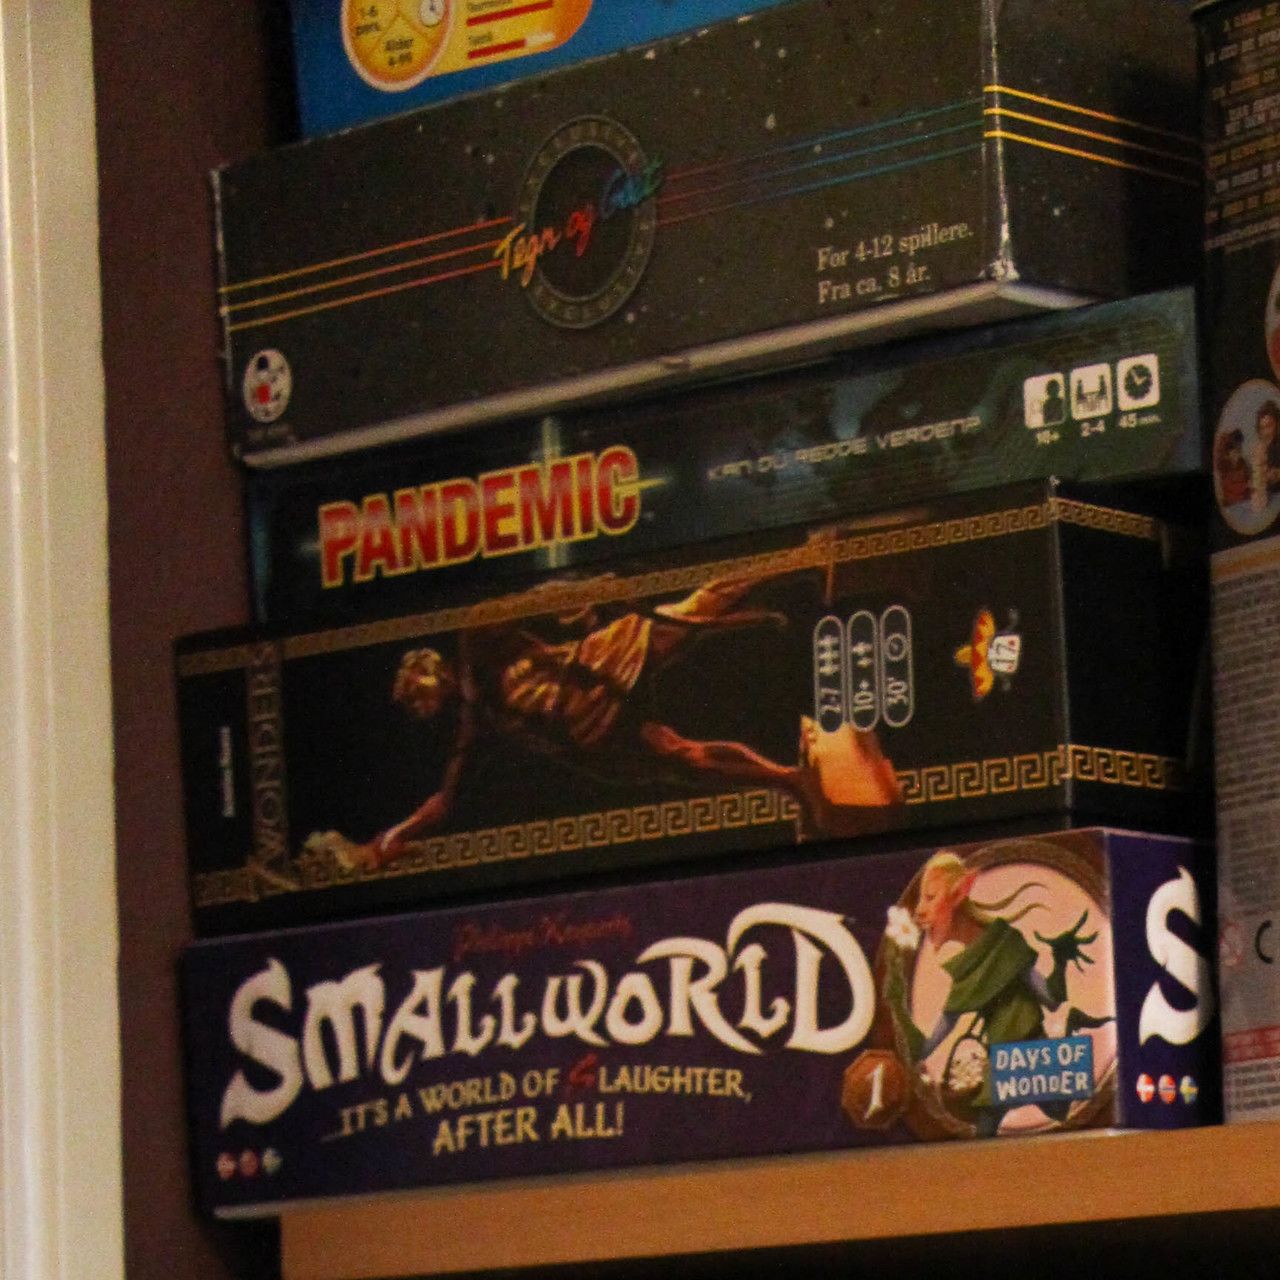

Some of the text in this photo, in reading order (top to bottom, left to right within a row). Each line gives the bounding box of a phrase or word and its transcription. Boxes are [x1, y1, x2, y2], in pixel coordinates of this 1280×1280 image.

[816, 221, 975, 271] For 4-12 spillere.
[818, 279, 850, 304] Fra
[319, 445, 641, 588] PANDEMIC
[995, 1043, 1088, 1071] DAYS OF
[419, 1070, 518, 1114] WORLD
[523, 1068, 561, 1098] OF
[433, 1100, 625, 1156] AFTER ALL!
